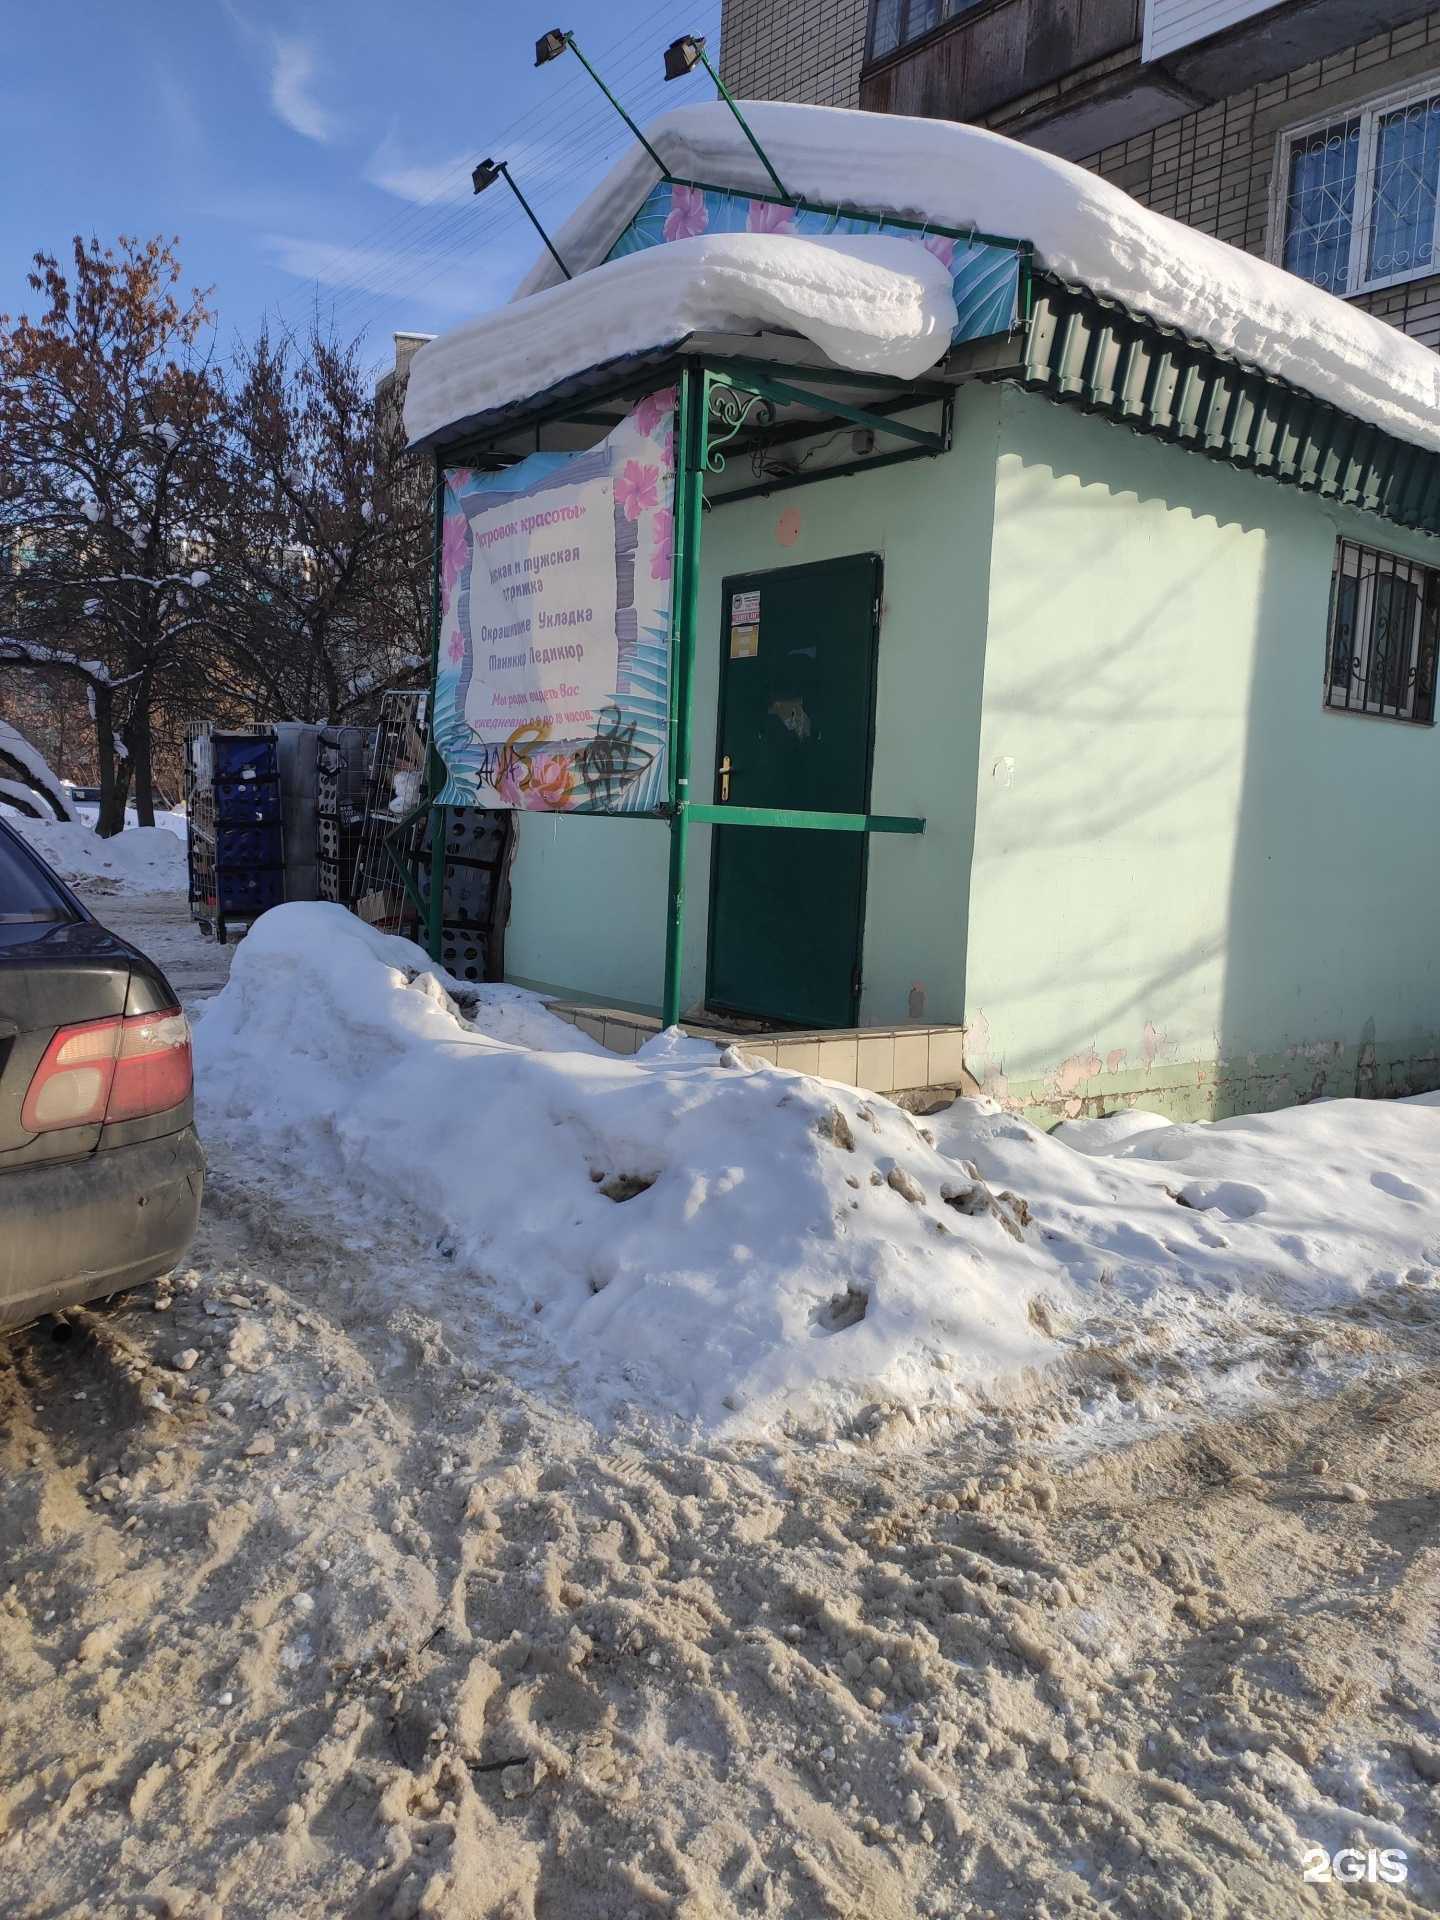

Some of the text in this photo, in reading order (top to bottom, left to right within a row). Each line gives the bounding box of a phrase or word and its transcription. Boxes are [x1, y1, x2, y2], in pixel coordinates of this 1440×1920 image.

[520, 503, 587, 535] красоты»
[538, 607, 593, 630] Укладка
[559, 682, 580, 698] Вас
